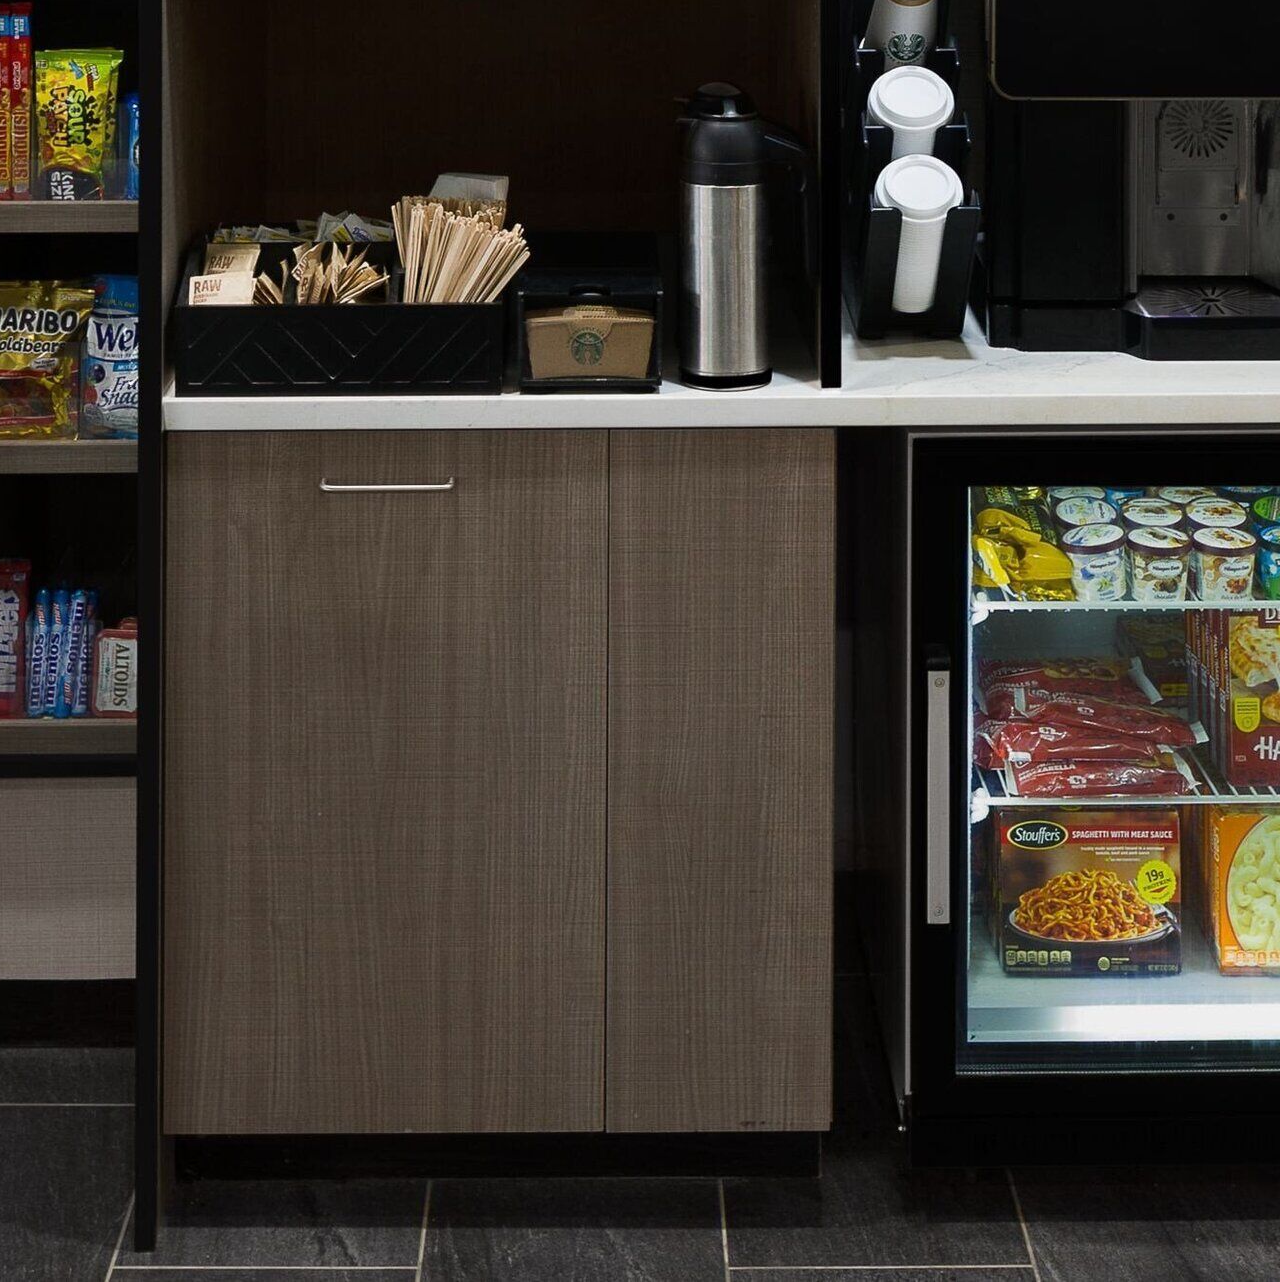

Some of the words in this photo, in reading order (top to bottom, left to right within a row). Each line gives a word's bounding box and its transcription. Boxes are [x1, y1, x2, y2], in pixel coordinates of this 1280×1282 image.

[51, 85, 70, 148] PATCH
[68, 88, 86, 146] SOUR
[209, 255, 236, 270] RAW
[193, 278, 223, 294] RAW
[29, 632, 47, 710] mentos
[45, 632, 61, 708] mentos
[113, 643, 130, 708] ALTOIDS
[1014, 826, 1061, 845] Stouffer's
[1071, 830, 1110, 839] SPAGHETTI
[1110, 830, 1130, 838] WITH
[1130, 830, 1149, 838] MEAT
[1150, 830, 1173, 838] SAUCE
[1145, 868, 1165, 883] 19g
